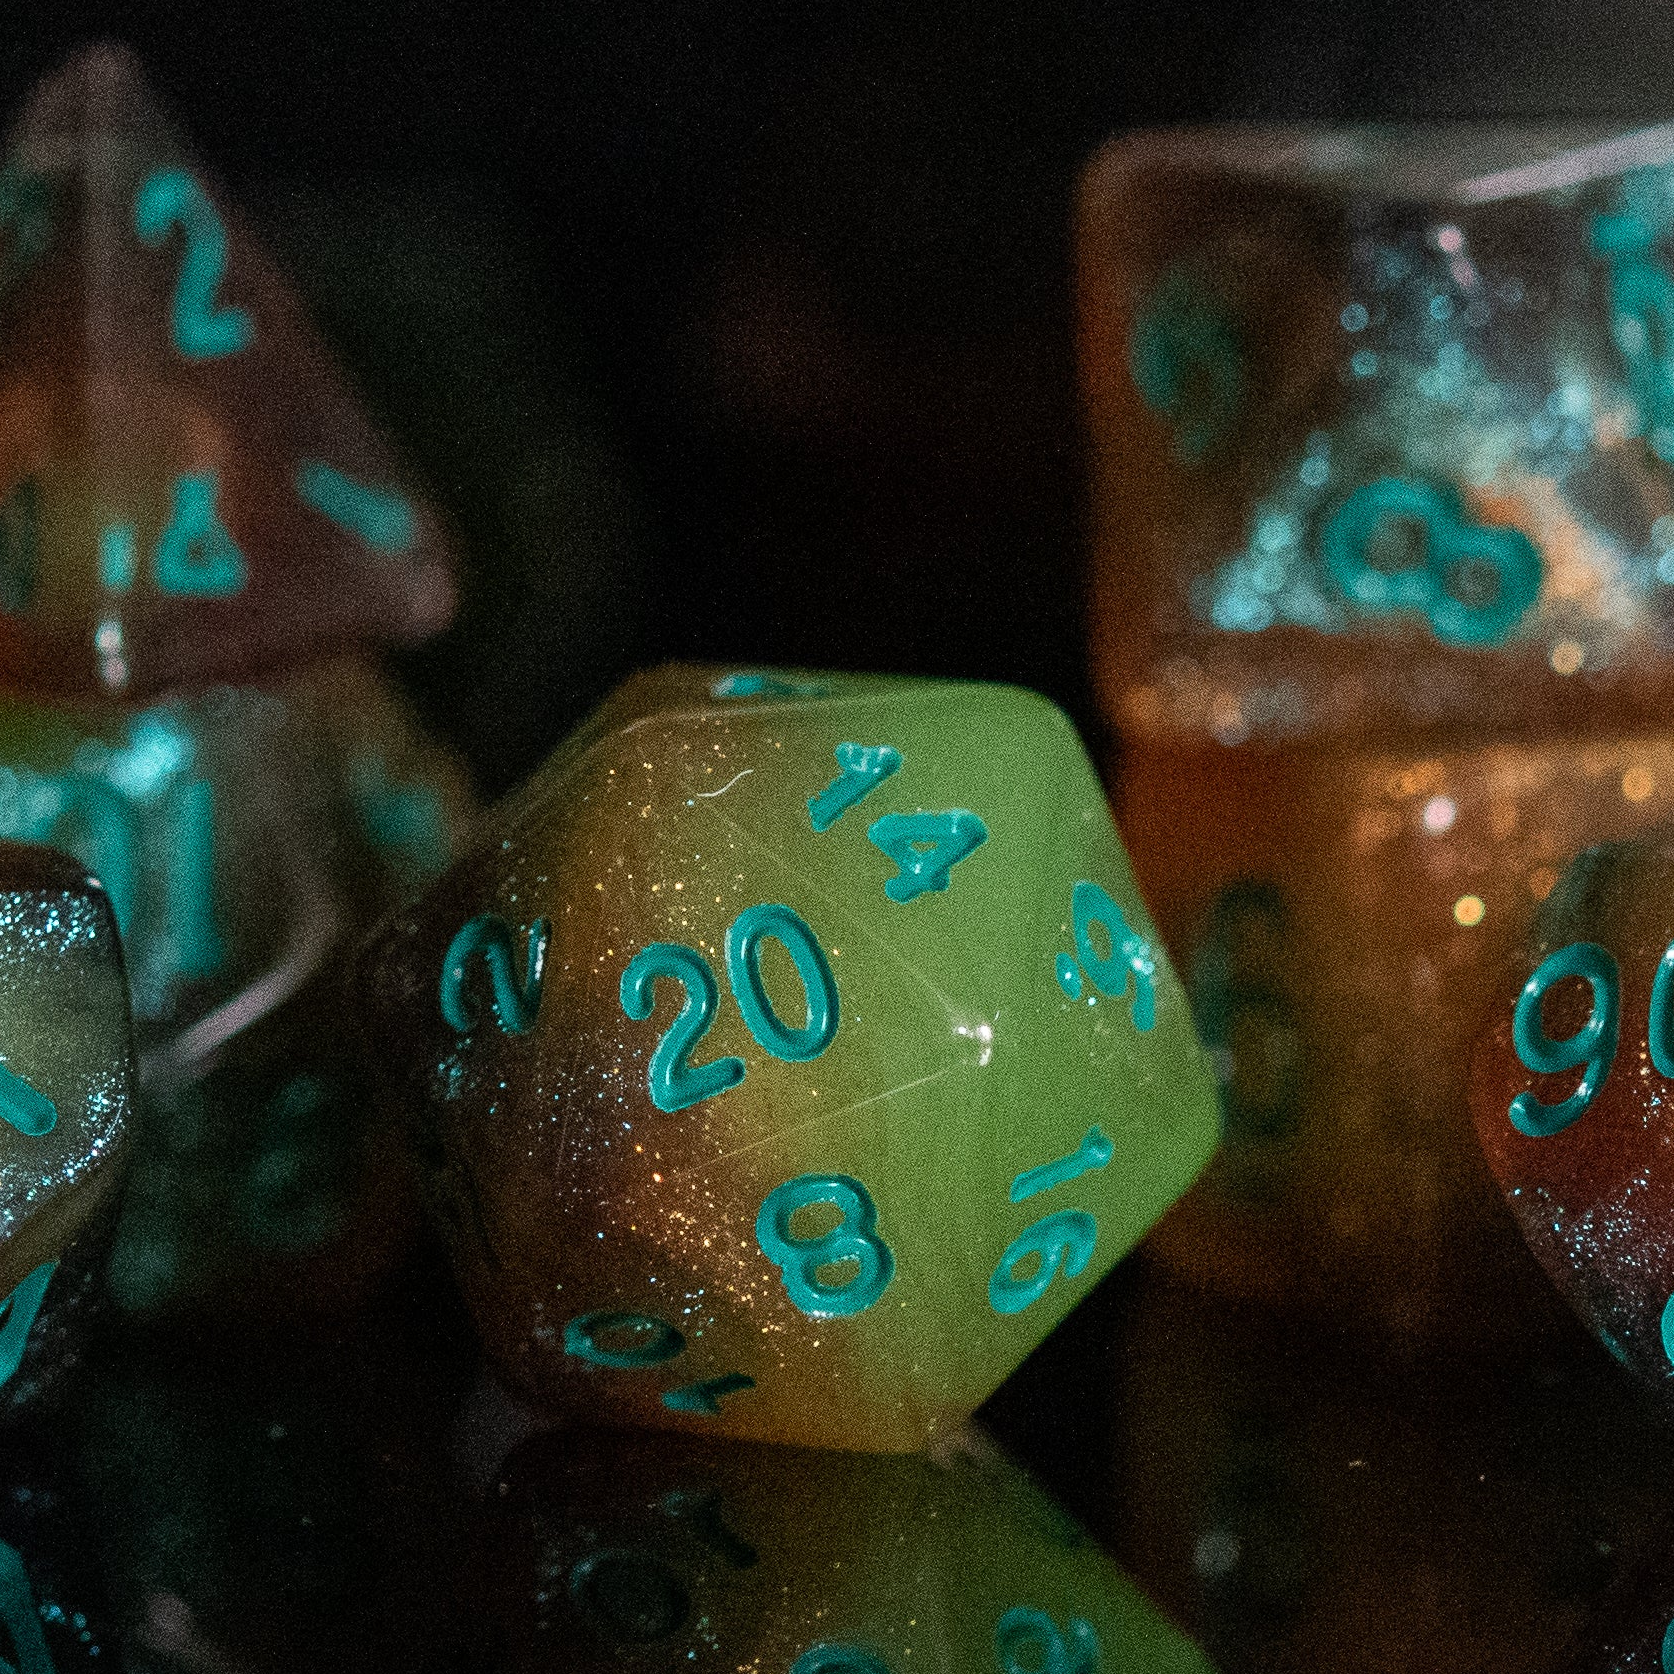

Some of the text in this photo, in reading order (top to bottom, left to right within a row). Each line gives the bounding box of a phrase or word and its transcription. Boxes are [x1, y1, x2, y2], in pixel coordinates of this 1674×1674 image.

[135, 168, 255, 360] 2
[1322, 475, 1544, 648] 8
[440, 912, 551, 1036] 2
[620, 903, 838, 1113] 20
[1508, 942, 1674, 1138] 9
[755, 1174, 895, 1318] 8
[988, 1127, 1113, 1313] 16
